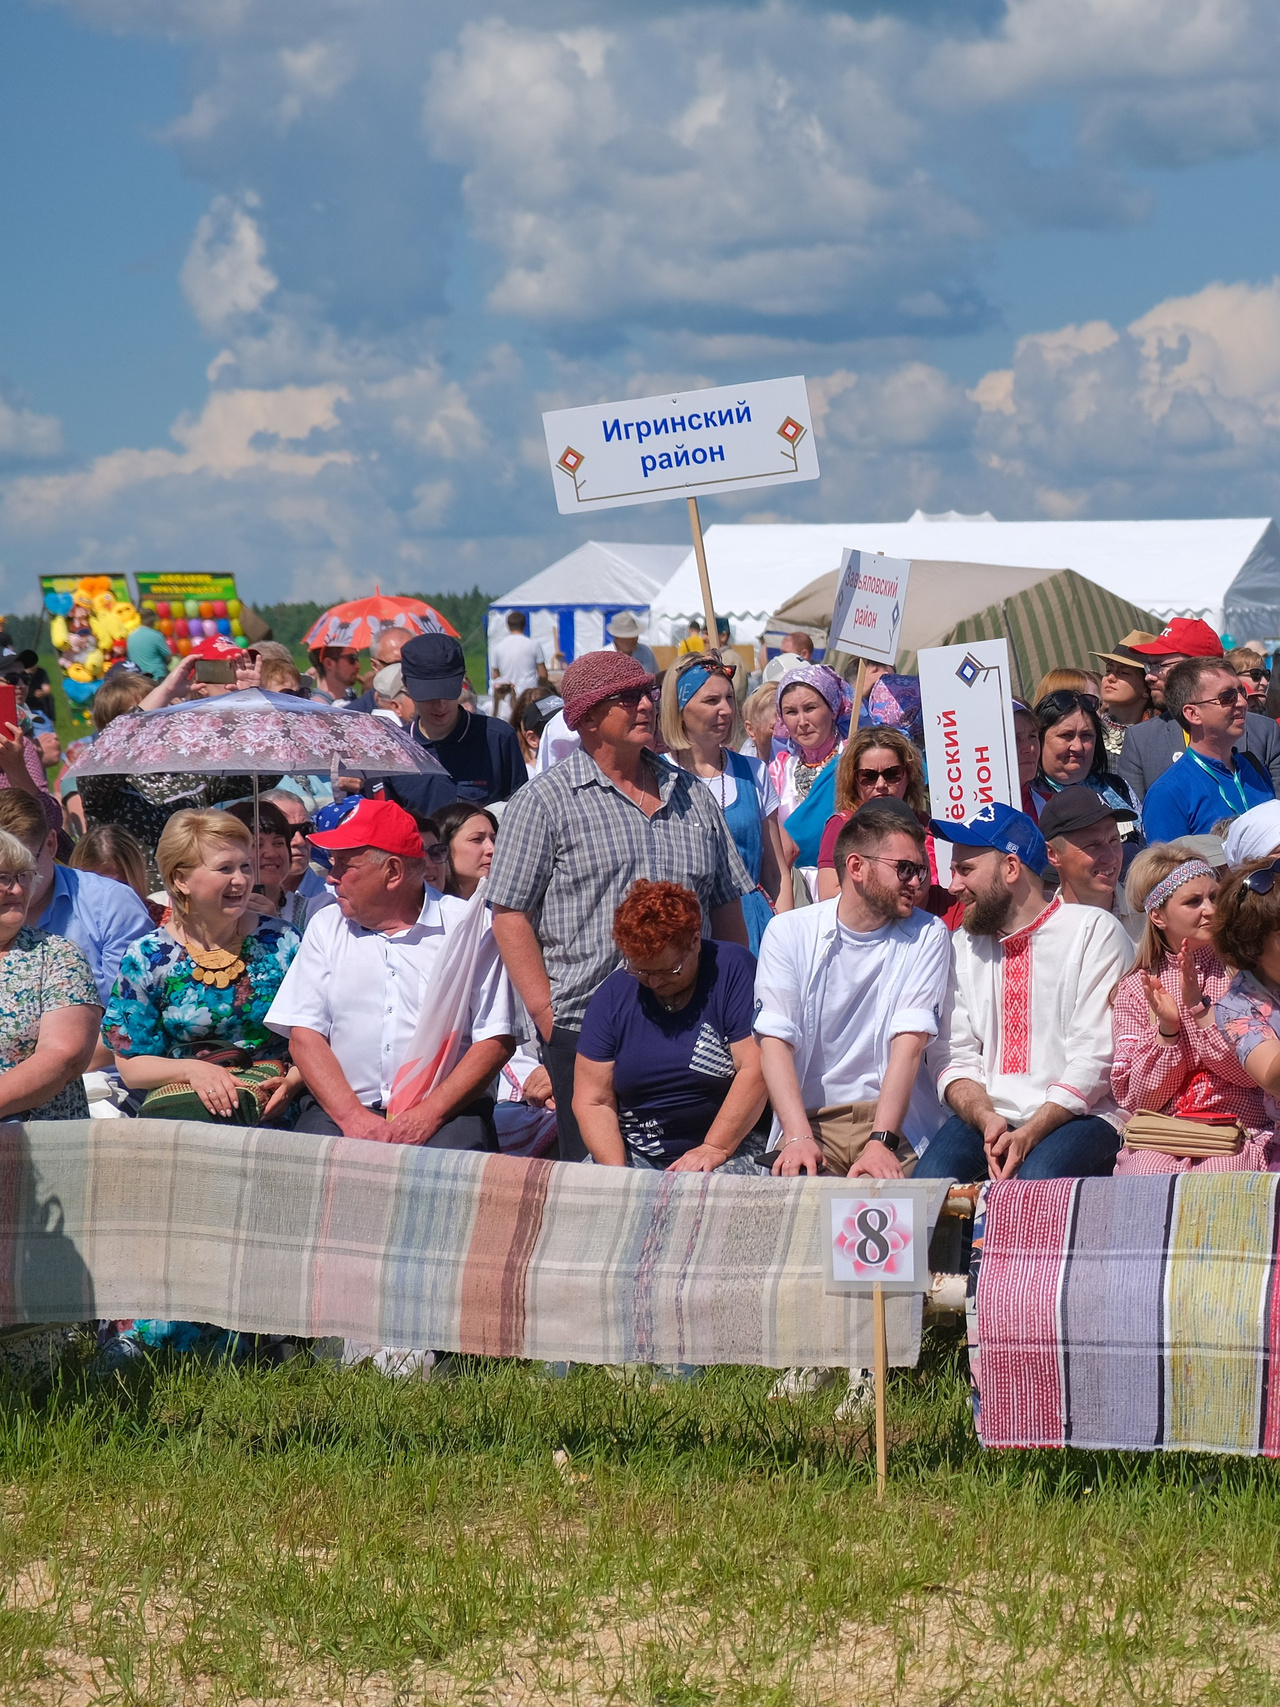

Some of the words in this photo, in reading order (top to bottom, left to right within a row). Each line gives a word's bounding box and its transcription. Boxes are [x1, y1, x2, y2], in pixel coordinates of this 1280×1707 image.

[602, 400, 752, 443] Игринский
[640, 444, 725, 478] район
[845, 565, 899, 599] Завьяловский
[853, 604, 878, 630] район
[936, 710, 965, 820] ёсский
[973, 746, 993, 804] йон
[856, 1208, 890, 1265] 8
